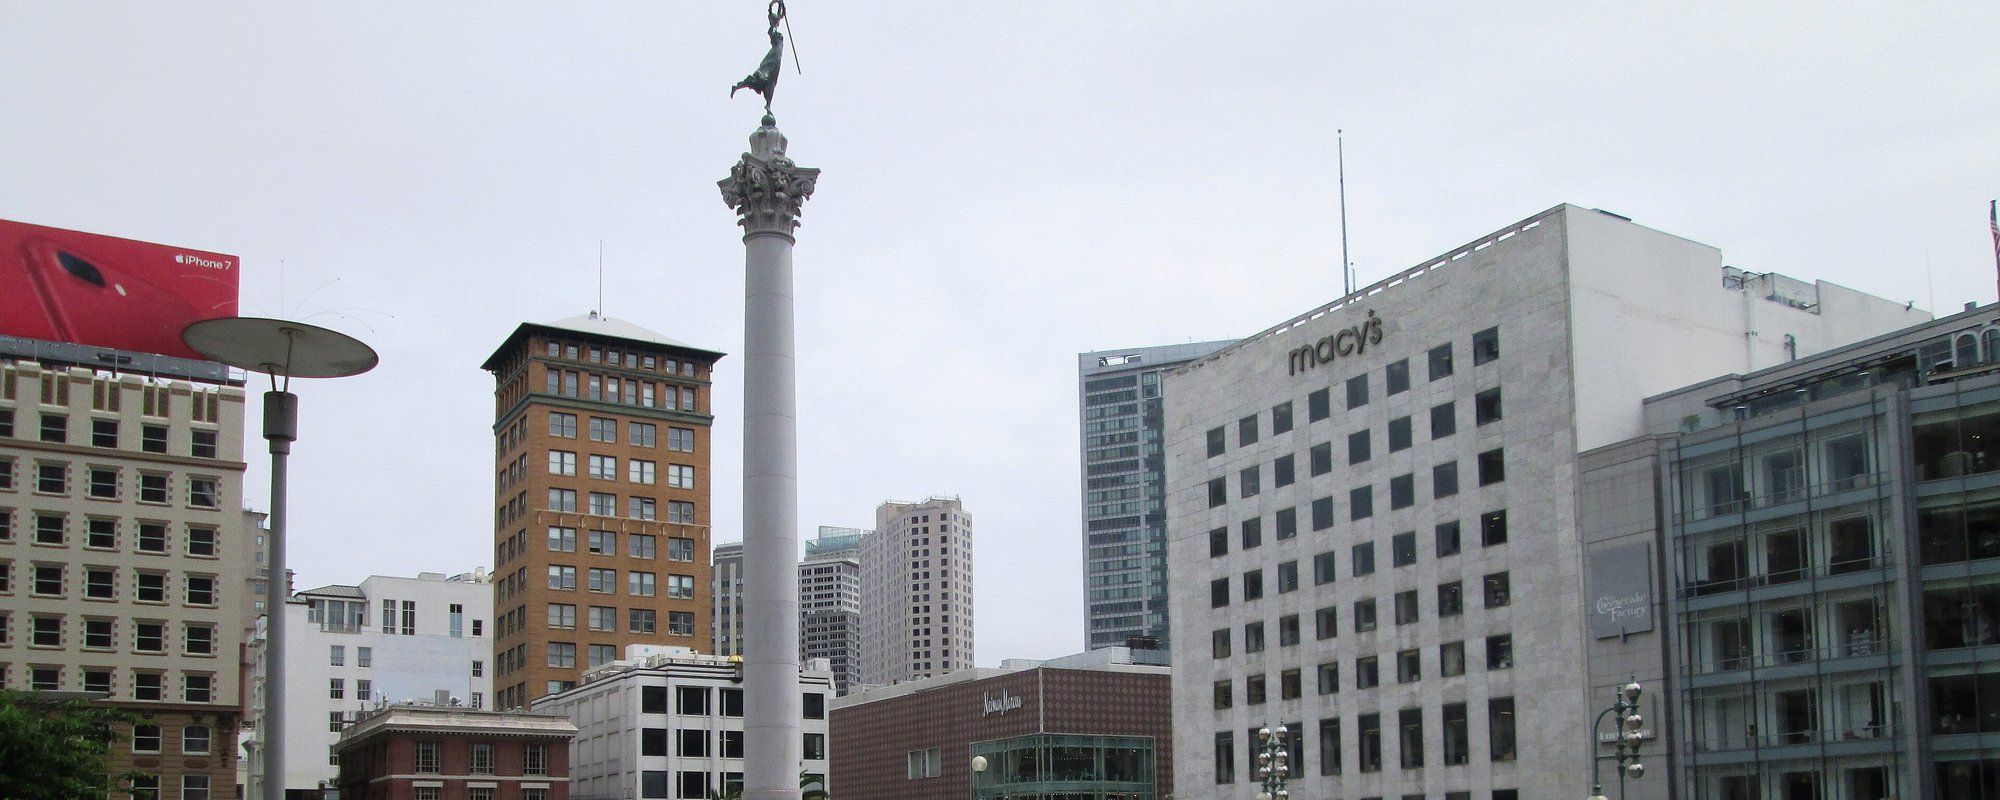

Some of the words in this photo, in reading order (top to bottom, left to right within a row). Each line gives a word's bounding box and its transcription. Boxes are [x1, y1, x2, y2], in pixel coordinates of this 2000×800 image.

[185, 255, 223, 270] iPhone
[224, 260, 232, 270] 7
[1610, 606, 1647, 624] Factory
